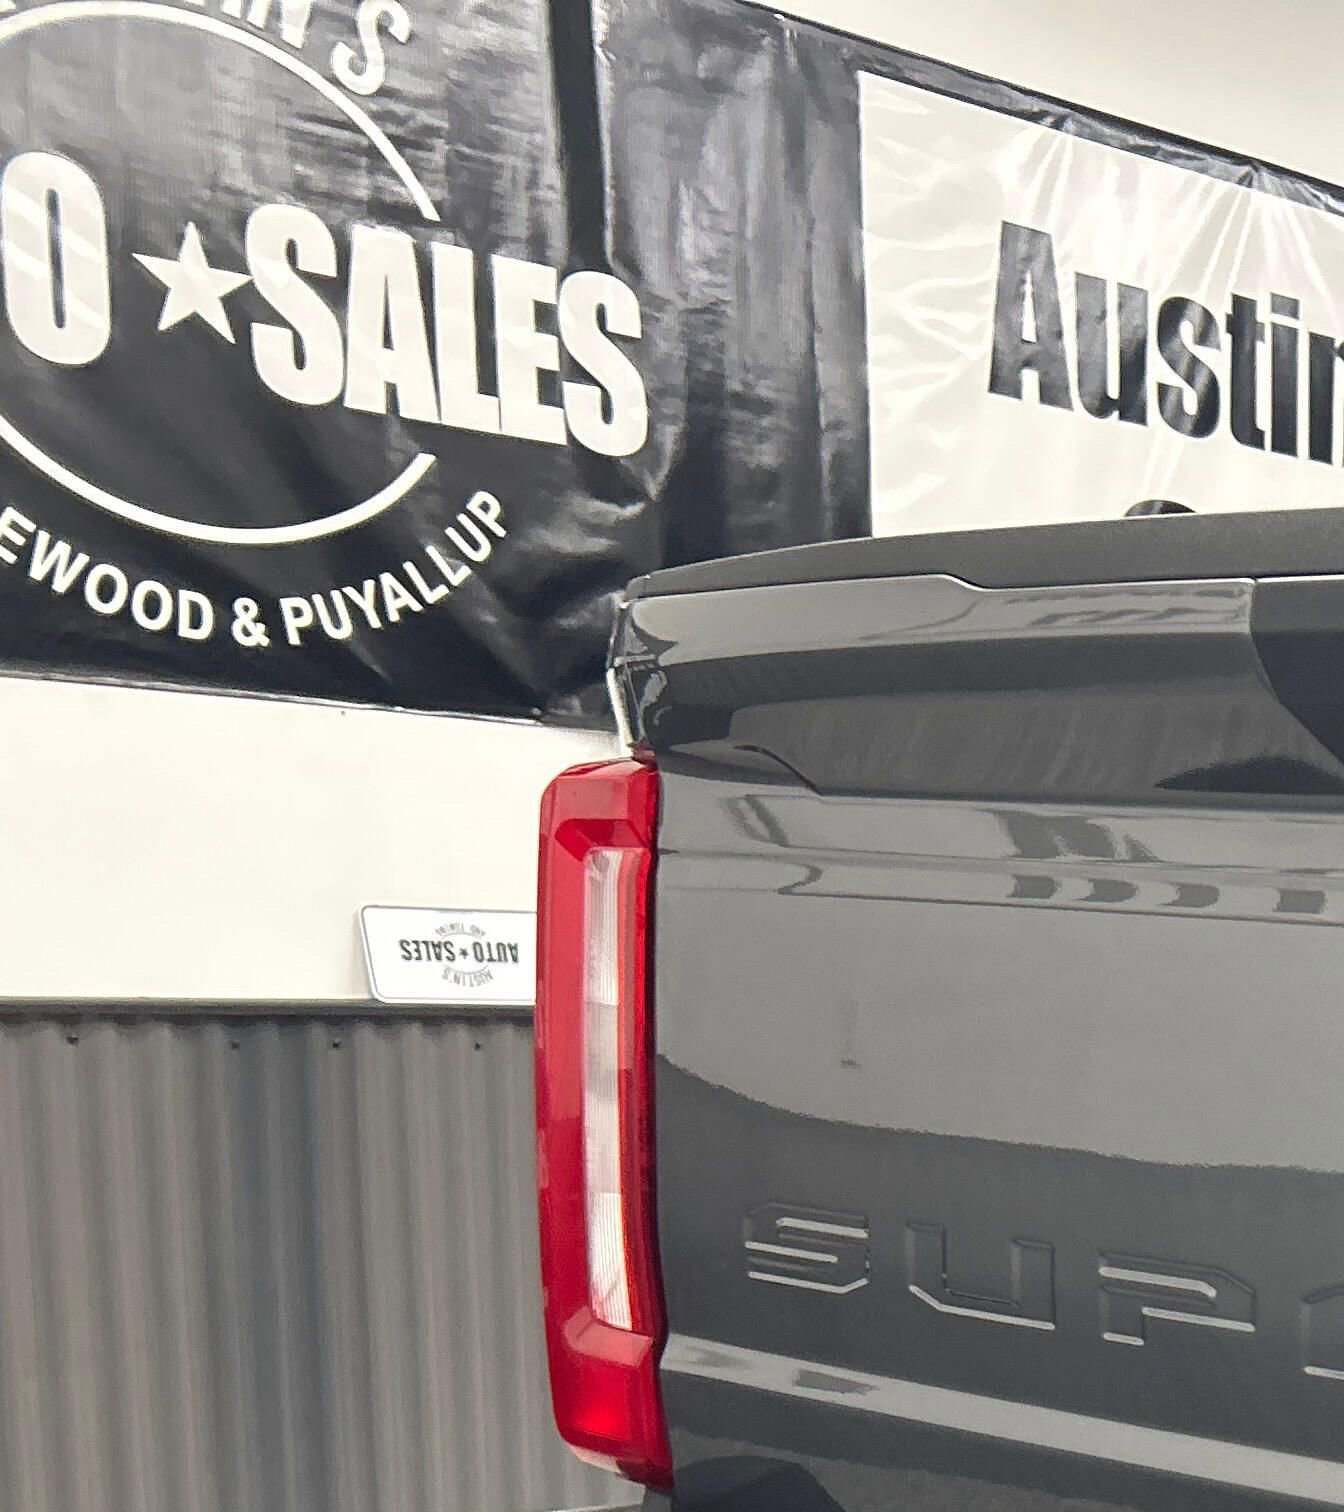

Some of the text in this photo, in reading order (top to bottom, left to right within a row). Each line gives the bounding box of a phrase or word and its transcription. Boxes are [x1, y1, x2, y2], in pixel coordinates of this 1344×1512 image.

[245, 203, 648, 457] SALES
[231, 597, 270, 648] &
[280, 490, 507, 646] PUYALLUP
[399, 939, 519, 963] AUTO SALES
